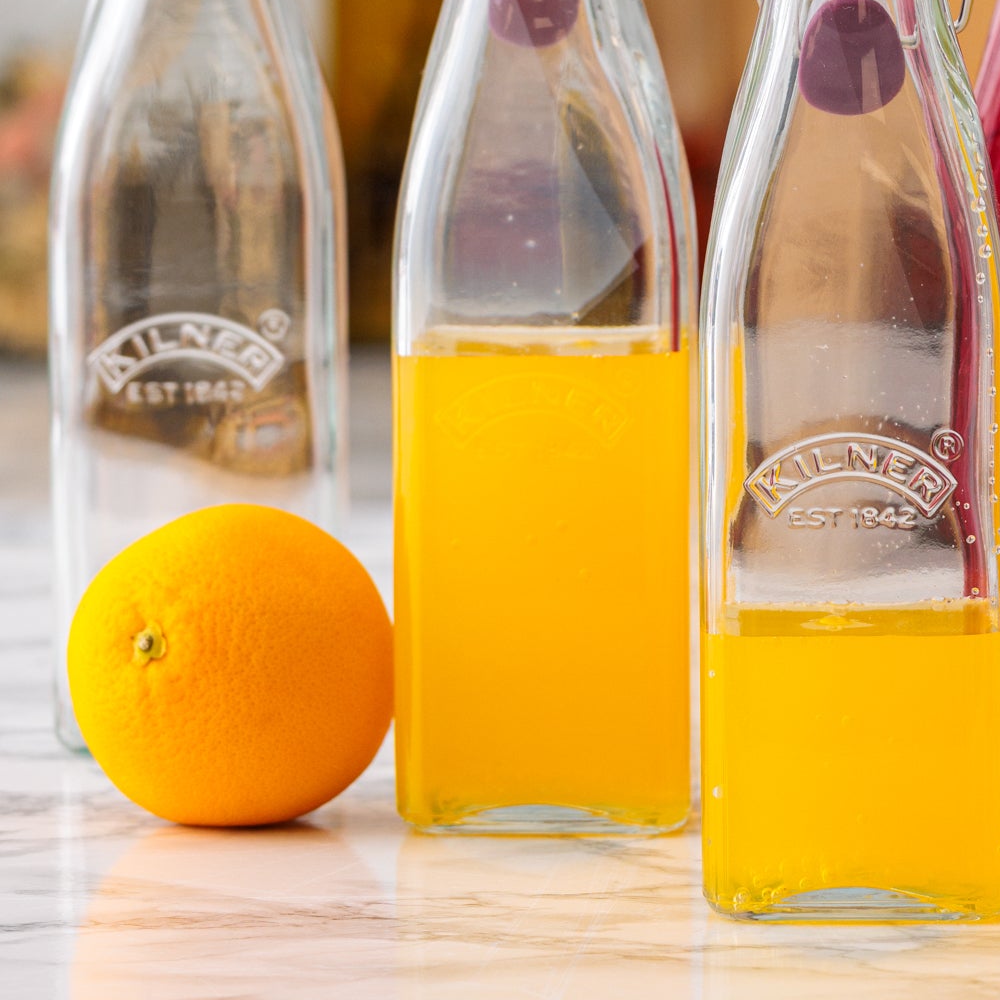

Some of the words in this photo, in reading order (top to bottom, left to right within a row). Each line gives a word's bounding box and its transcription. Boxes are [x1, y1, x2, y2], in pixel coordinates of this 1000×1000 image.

[99, 322, 269, 384] KILNER
[126, 381, 178, 403] EST
[757, 441, 946, 503] KILNER
[787, 506, 843, 530] EST
[851, 506, 918, 530] 1842
